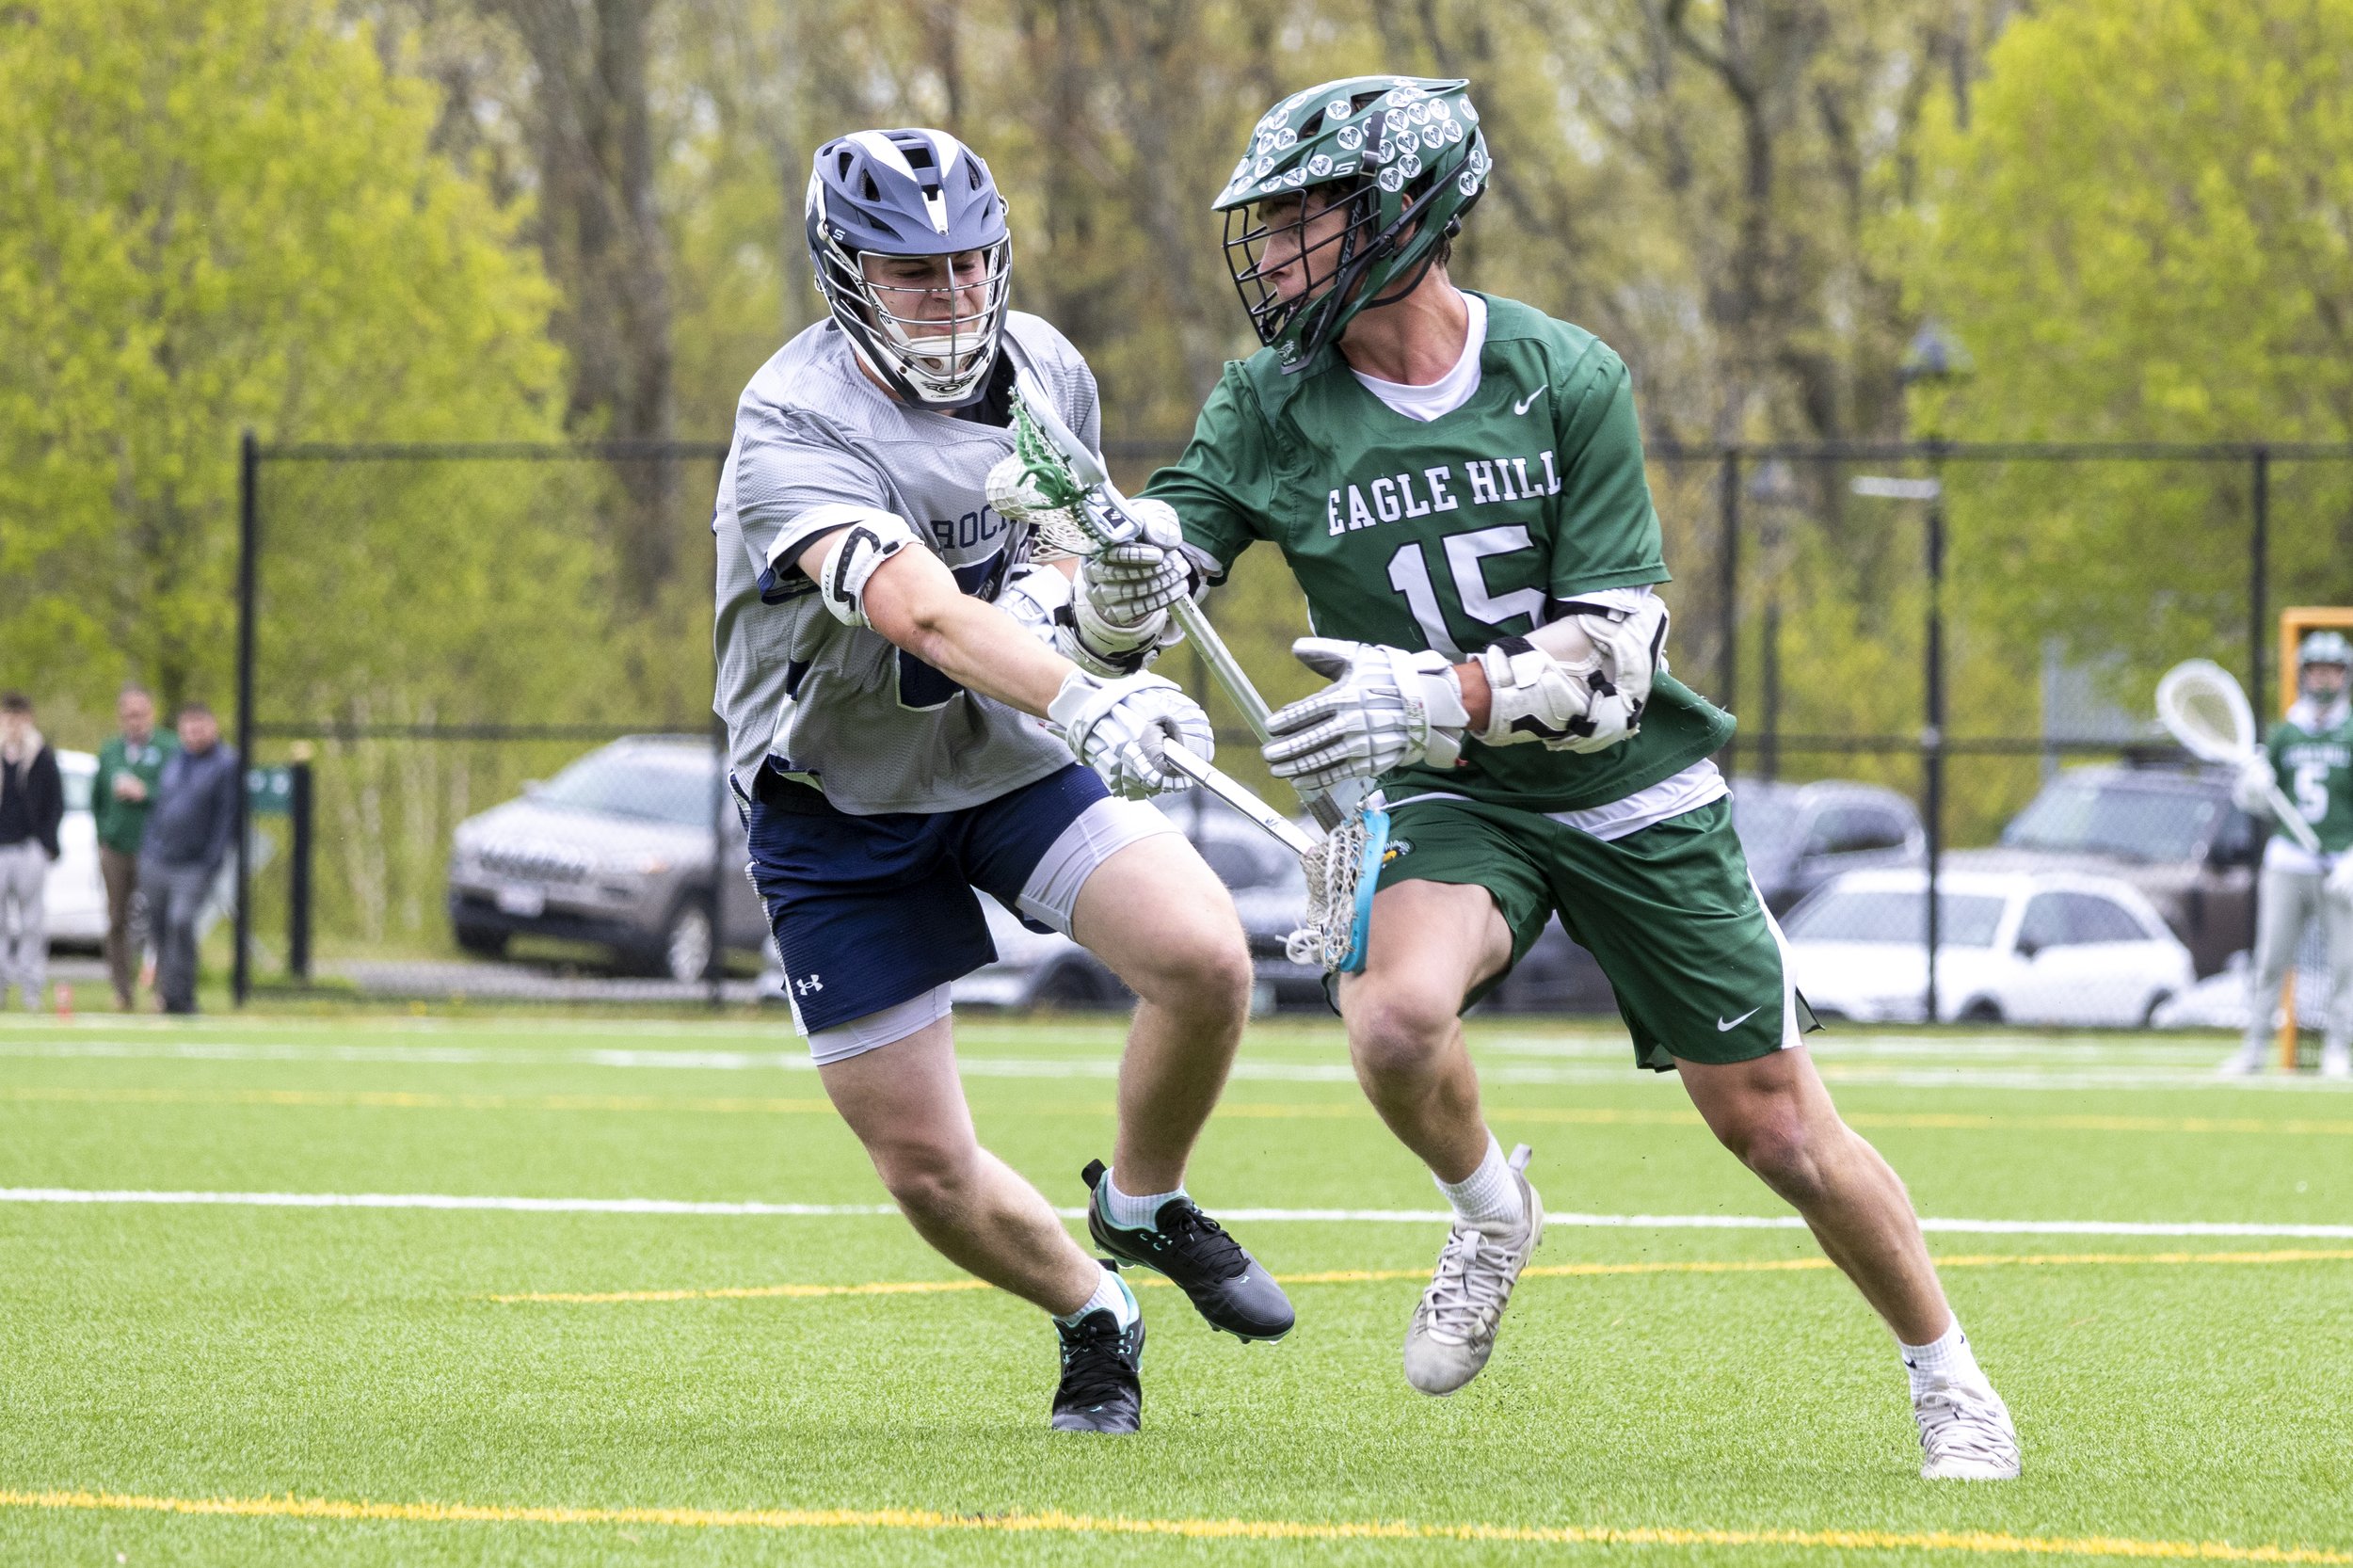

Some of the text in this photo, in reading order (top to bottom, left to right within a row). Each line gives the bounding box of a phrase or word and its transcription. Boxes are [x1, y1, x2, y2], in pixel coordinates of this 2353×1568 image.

[1328, 450, 1561, 537] EAGLE HILL
[1386, 522, 1549, 655] 15
[2295, 763, 2329, 825] 5
